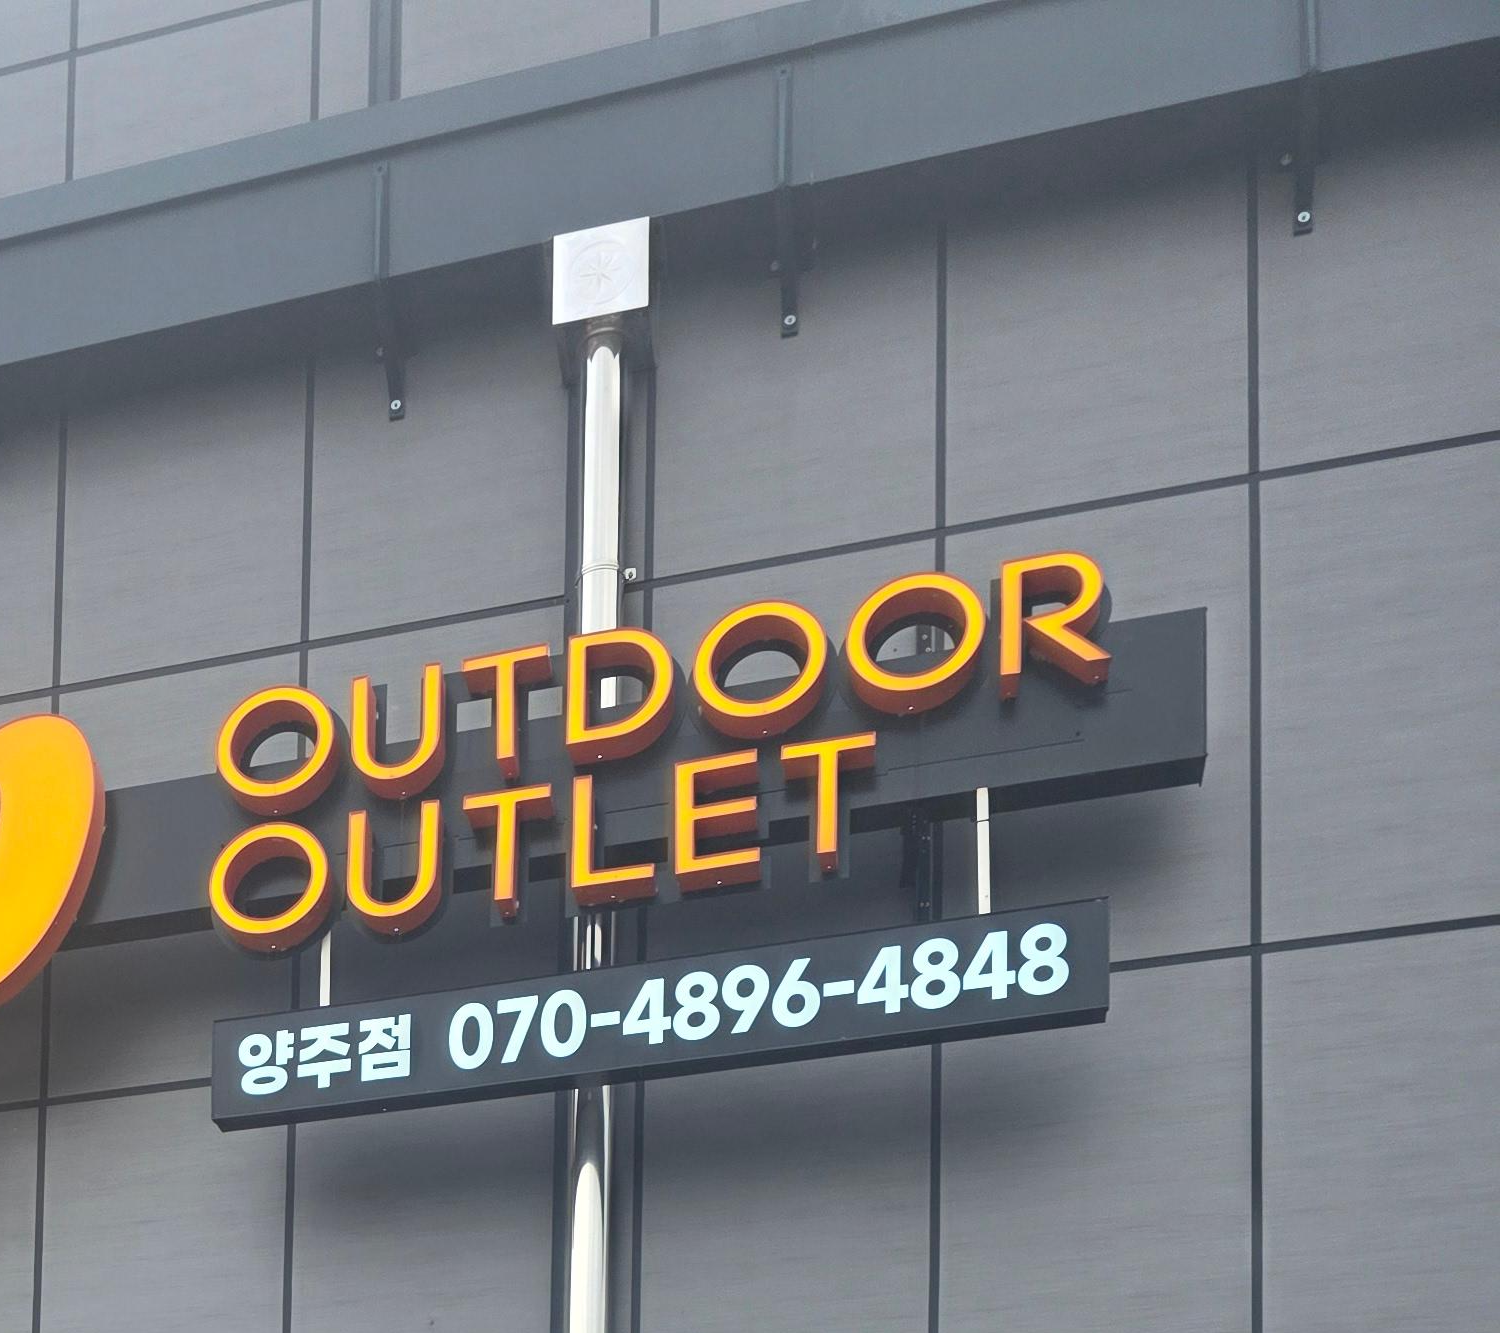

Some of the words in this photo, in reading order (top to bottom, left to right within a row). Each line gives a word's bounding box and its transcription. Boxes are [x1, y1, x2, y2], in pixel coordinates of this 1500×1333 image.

[216, 551, 1111, 814] OUTDOOR
[208, 732, 877, 953] OUTLET
[238, 1011, 412, 1097] 양주점
[448, 922, 1070, 1072] 070-4896-4848
